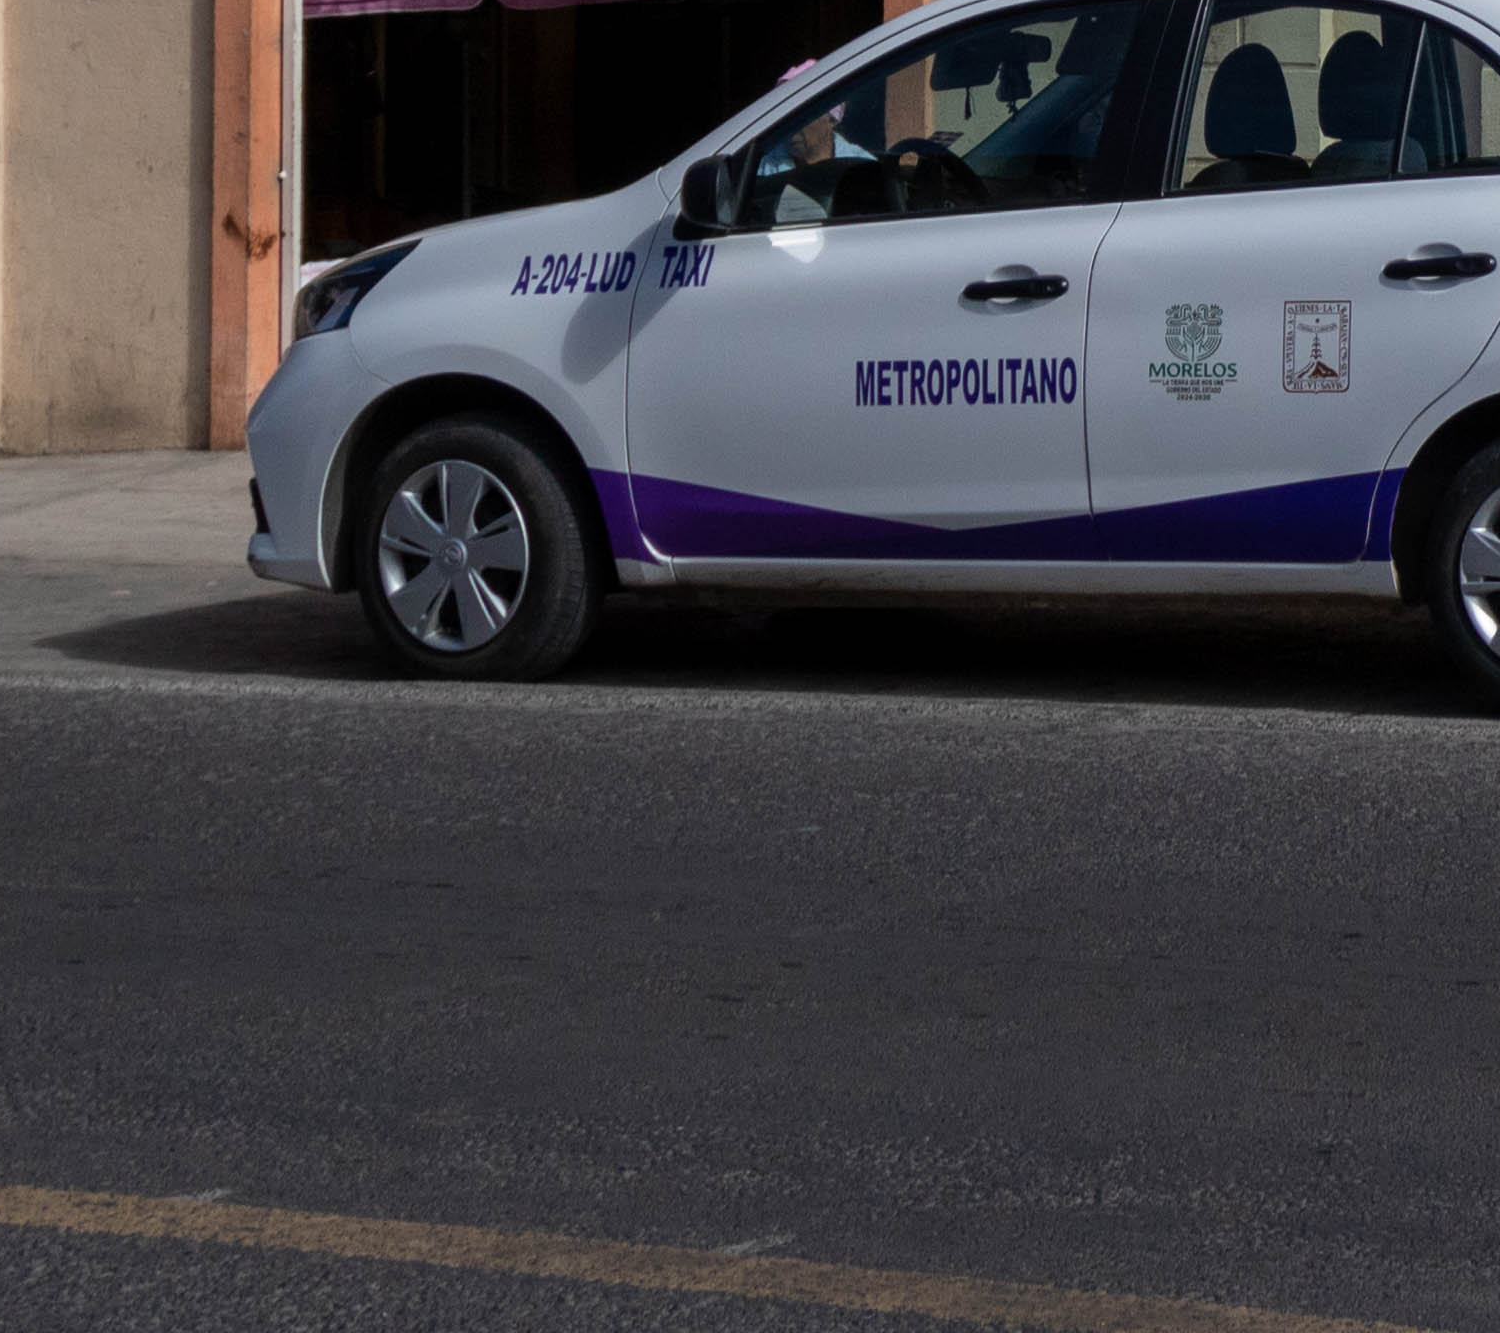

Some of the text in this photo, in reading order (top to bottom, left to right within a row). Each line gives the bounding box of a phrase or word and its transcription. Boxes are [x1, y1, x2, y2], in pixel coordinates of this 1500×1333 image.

[510, 244, 716, 296] A-204-LUD TAXI
[855, 357, 1078, 407] METROPOLITANO
[1148, 362, 1238, 378] MORELOS
